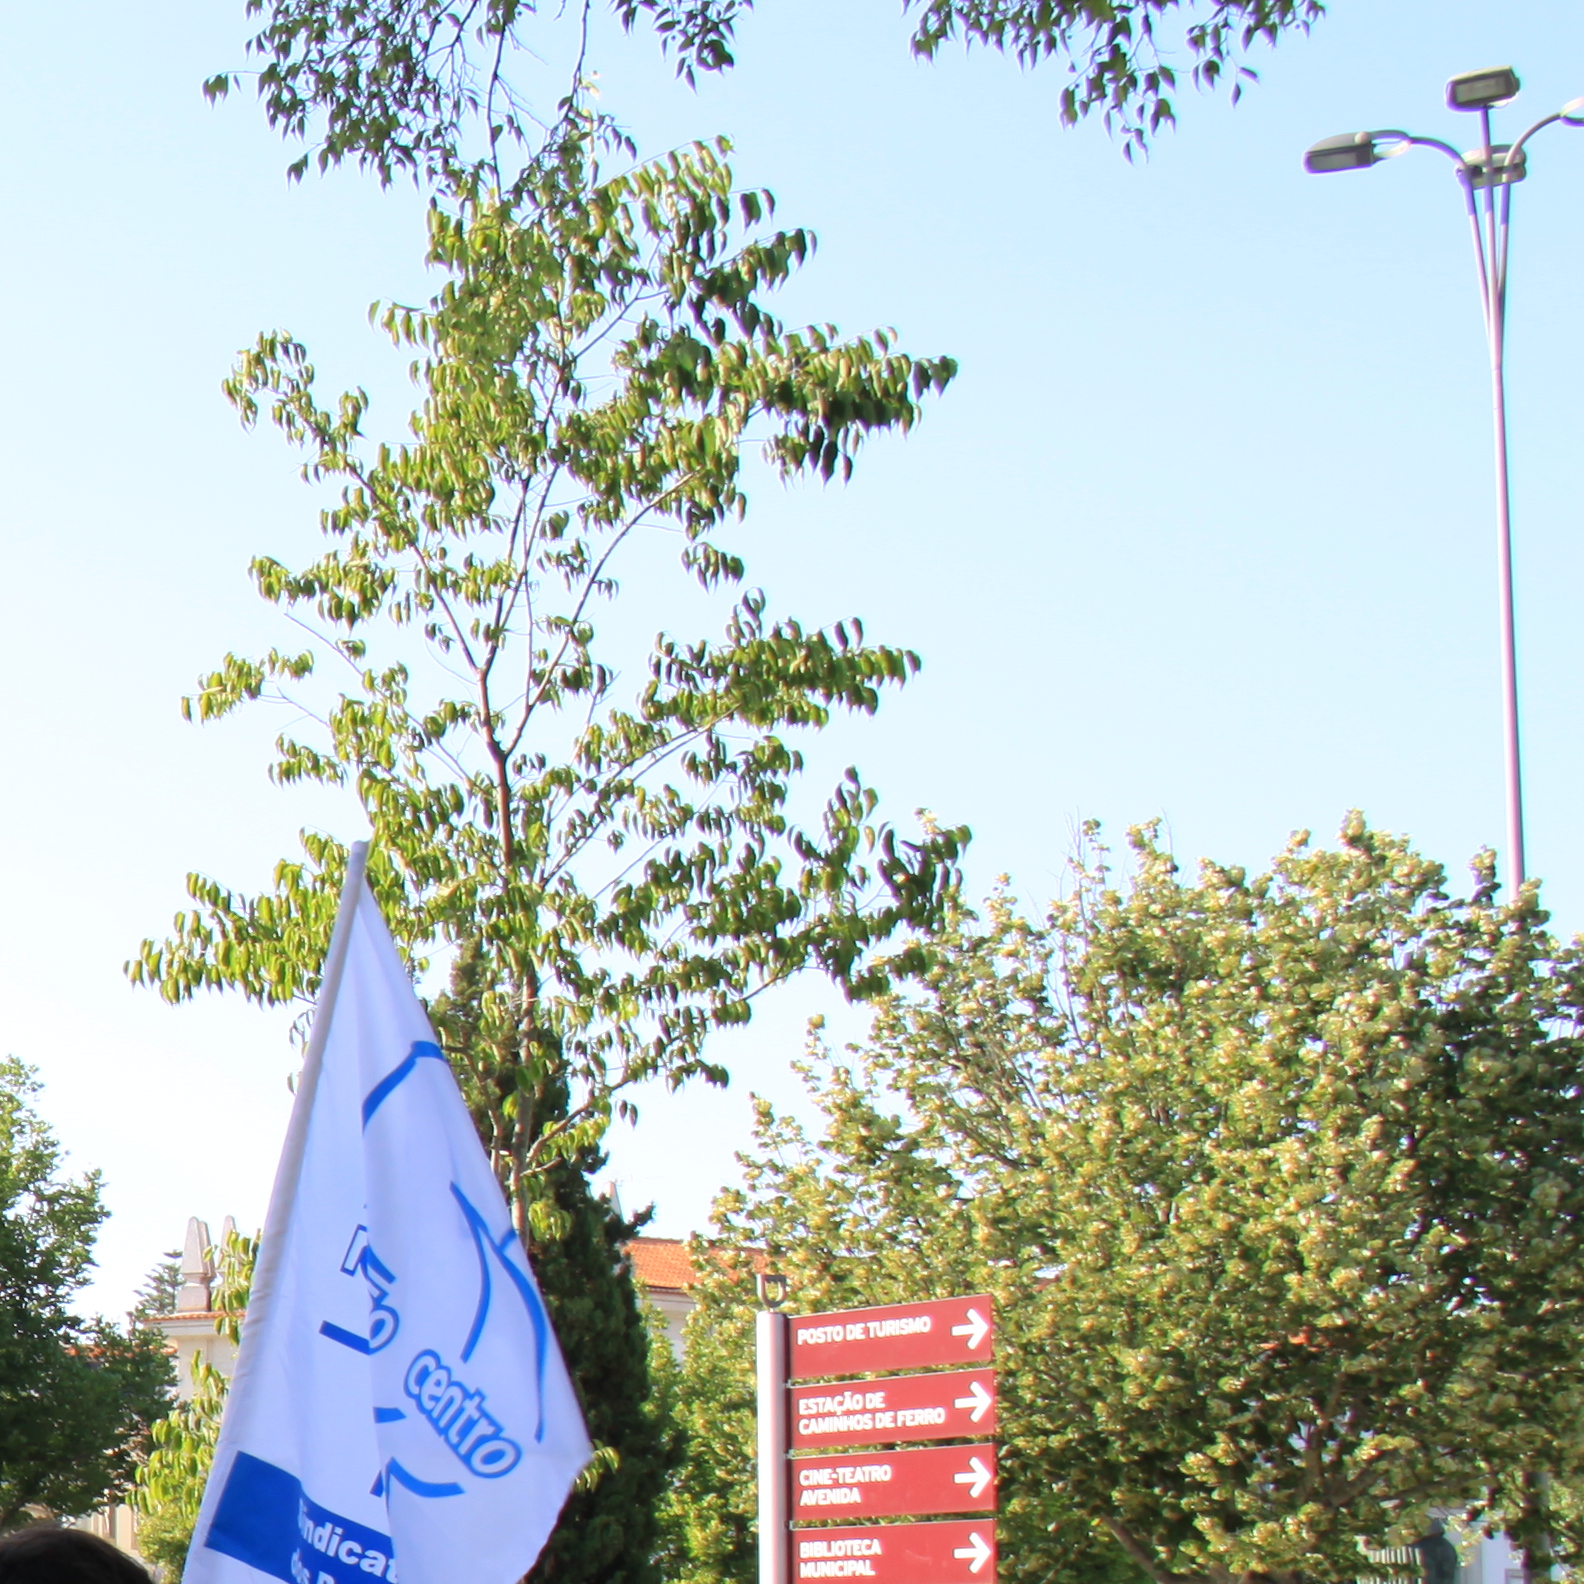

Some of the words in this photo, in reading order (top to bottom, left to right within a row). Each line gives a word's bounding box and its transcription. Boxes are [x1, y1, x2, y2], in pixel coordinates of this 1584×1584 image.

[797, 1326, 843, 1345] POSTO
[847, 1322, 865, 1340] DE
[867, 1316, 931, 1338] TURISMO
[403, 1348, 522, 1480] centro
[798, 1392, 864, 1416] ESTAÇÃO
[868, 1392, 885, 1410] DE
[798, 1414, 873, 1435] CAMINHOS
[876, 1410, 895, 1428] DE
[897, 1408, 945, 1427] FERRO
[799, 1465, 892, 1486] CINE-TEATRO
[799, 1487, 861, 1506] AVENIDA
[799, 1539, 881, 1558] BIBLIOTECA
[799, 1558, 875, 1578] MUNICIPAL
